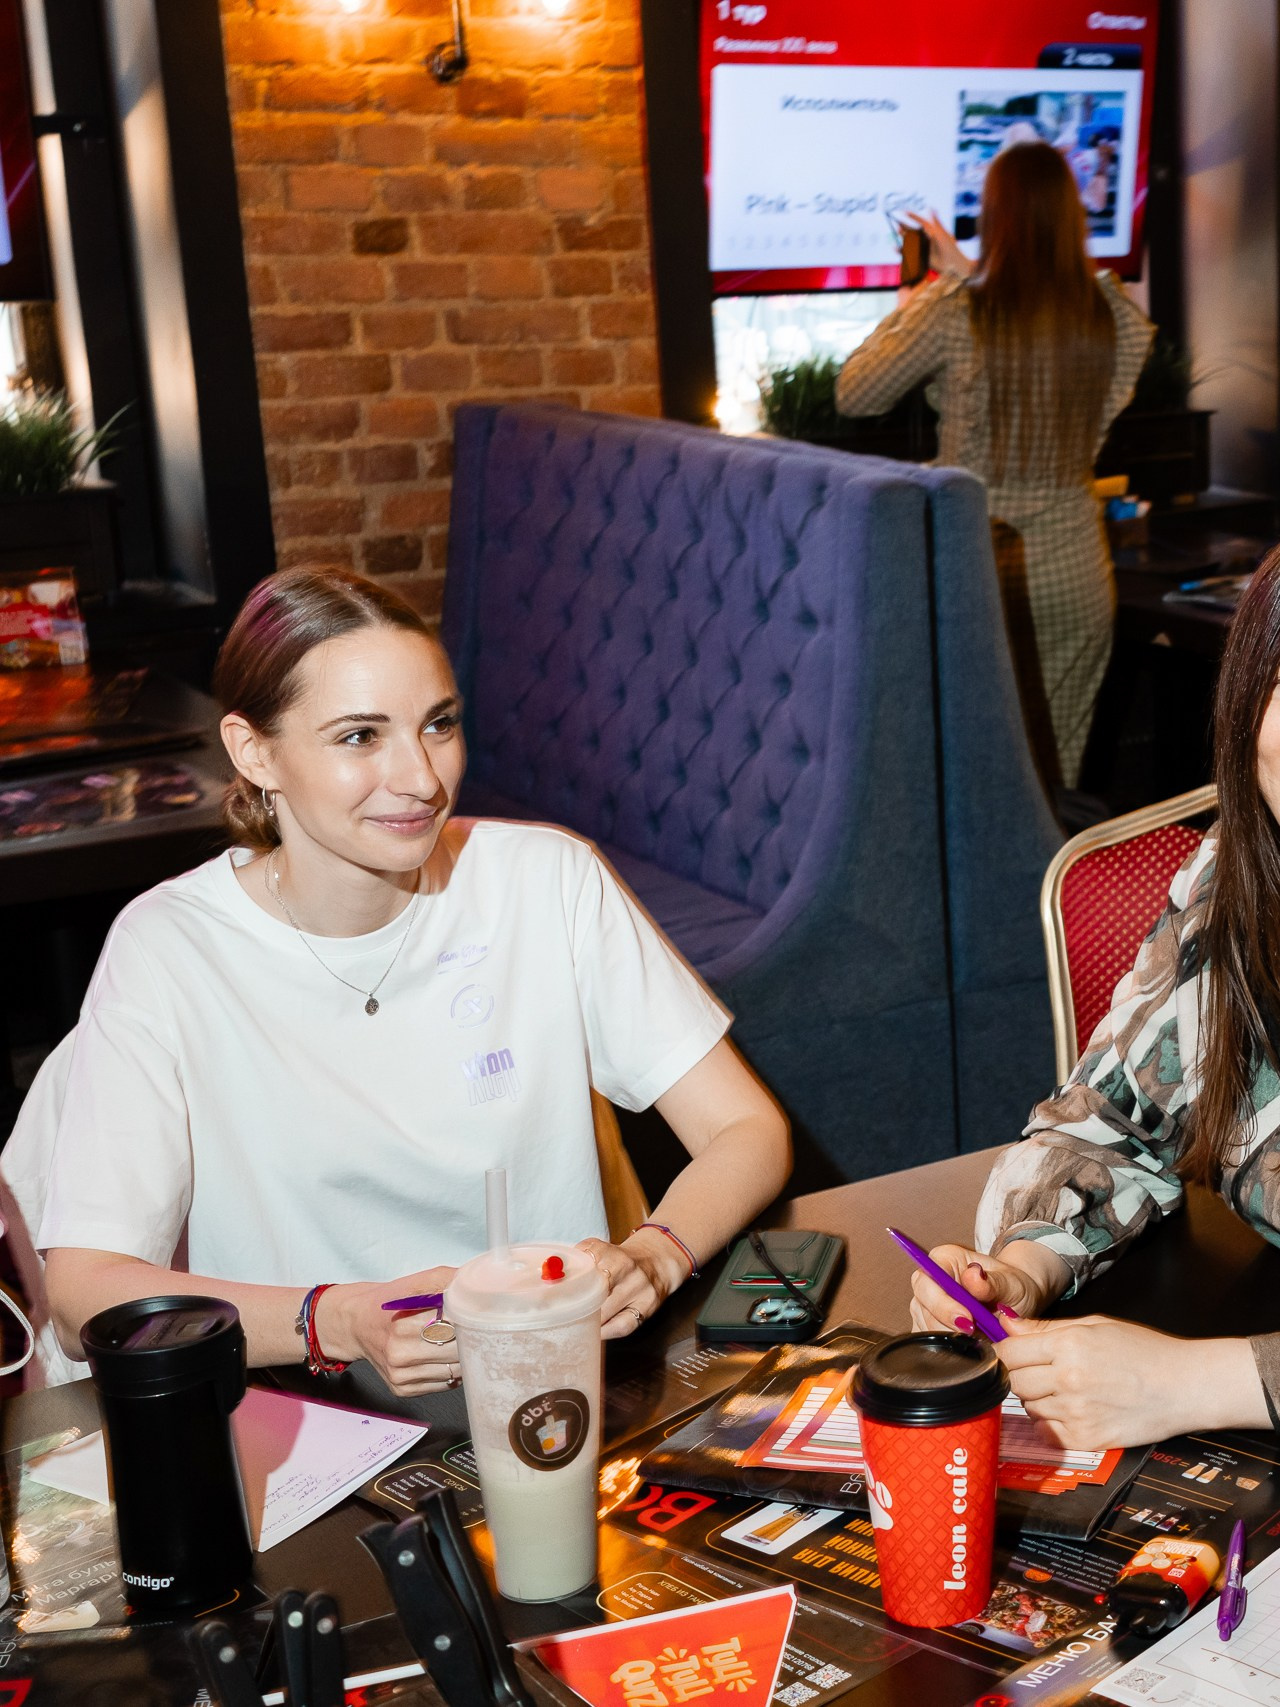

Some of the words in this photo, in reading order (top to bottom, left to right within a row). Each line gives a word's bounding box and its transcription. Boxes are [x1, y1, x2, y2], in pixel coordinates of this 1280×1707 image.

[746, 193, 791, 214] Pink
[814, 192, 879, 216] Stupid
[944, 1448, 968, 1515] cafe
[792, 1547, 836, 1569] ДЛЯ
[943, 1523, 967, 1590] leon
[122, 1571, 170, 1590] contigo
[658, 1580, 678, 1593] ХЛЕБ
[1016, 1641, 1091, 1688] МЕНЮ
[1083, 1614, 1118, 1642] БА
